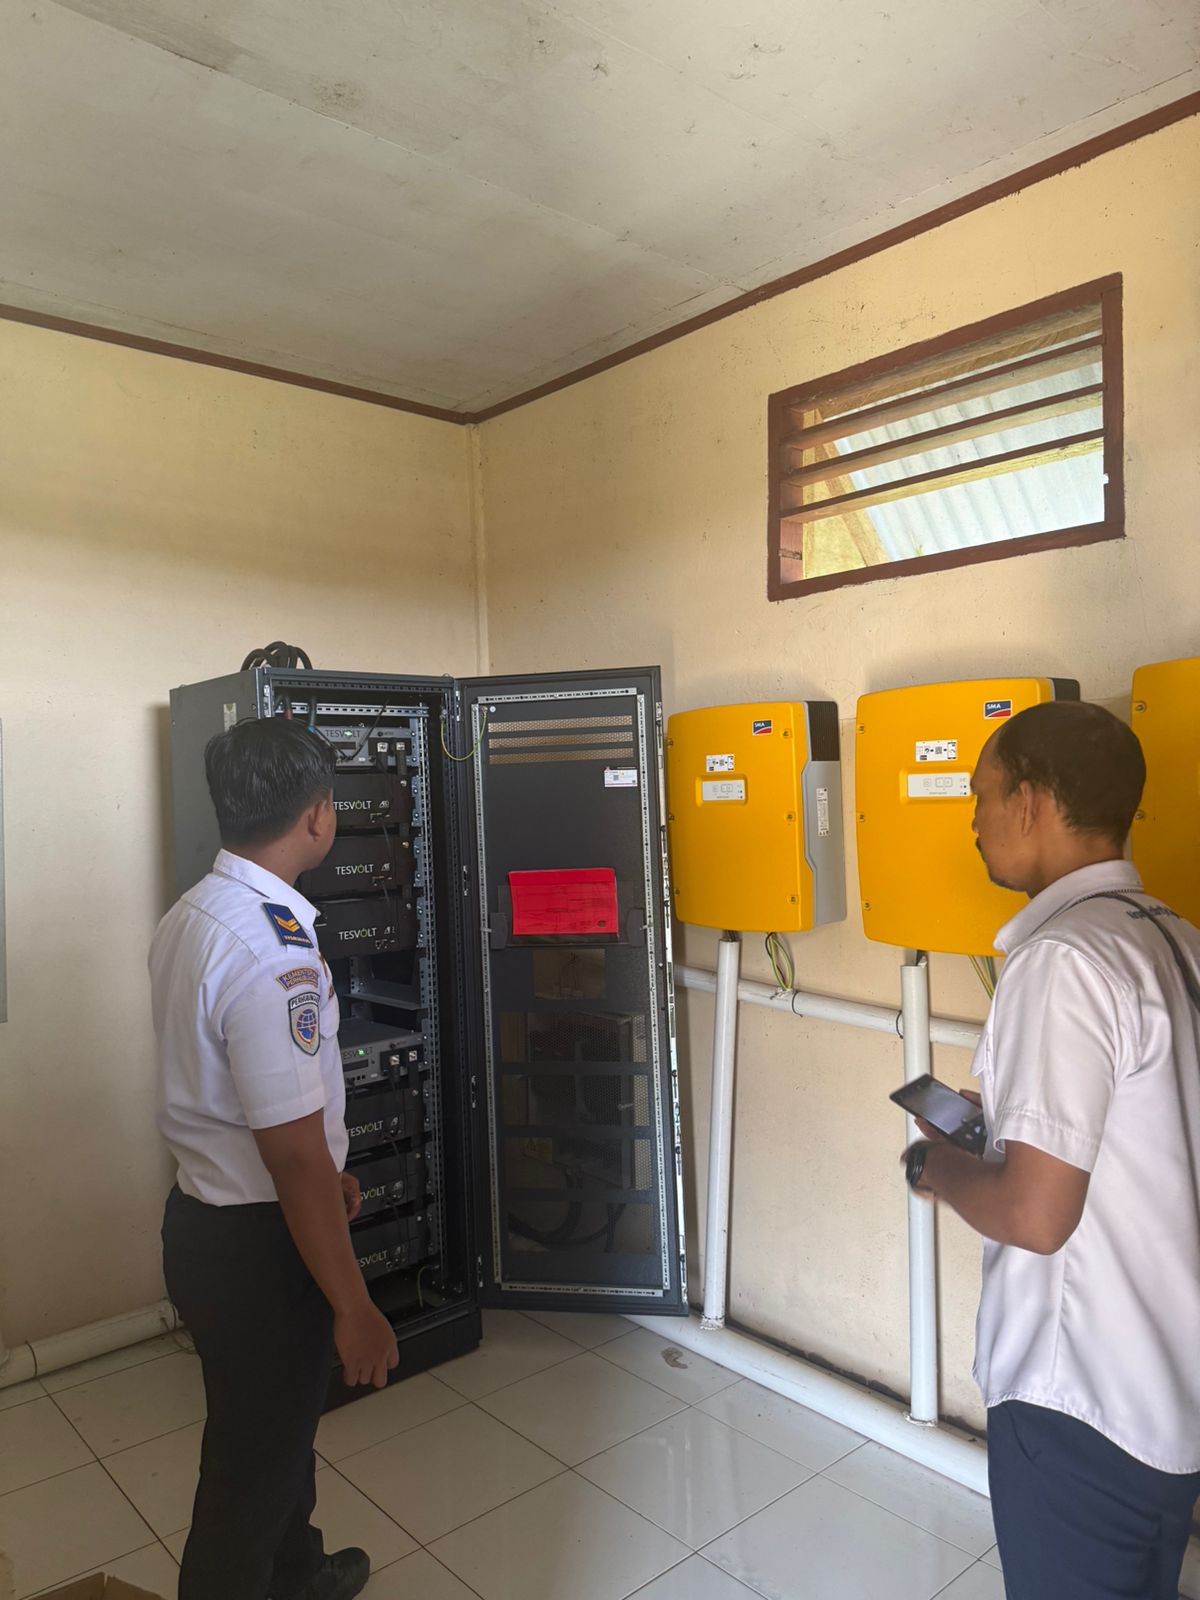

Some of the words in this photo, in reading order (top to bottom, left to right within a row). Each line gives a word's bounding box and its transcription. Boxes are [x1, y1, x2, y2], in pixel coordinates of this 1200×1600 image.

[333, 800, 372, 811] TESVOLT
[335, 864, 374, 876] TESVOLT
[338, 928, 377, 941] TESVOLT
[357, 1250, 388, 1268] SVOLT
